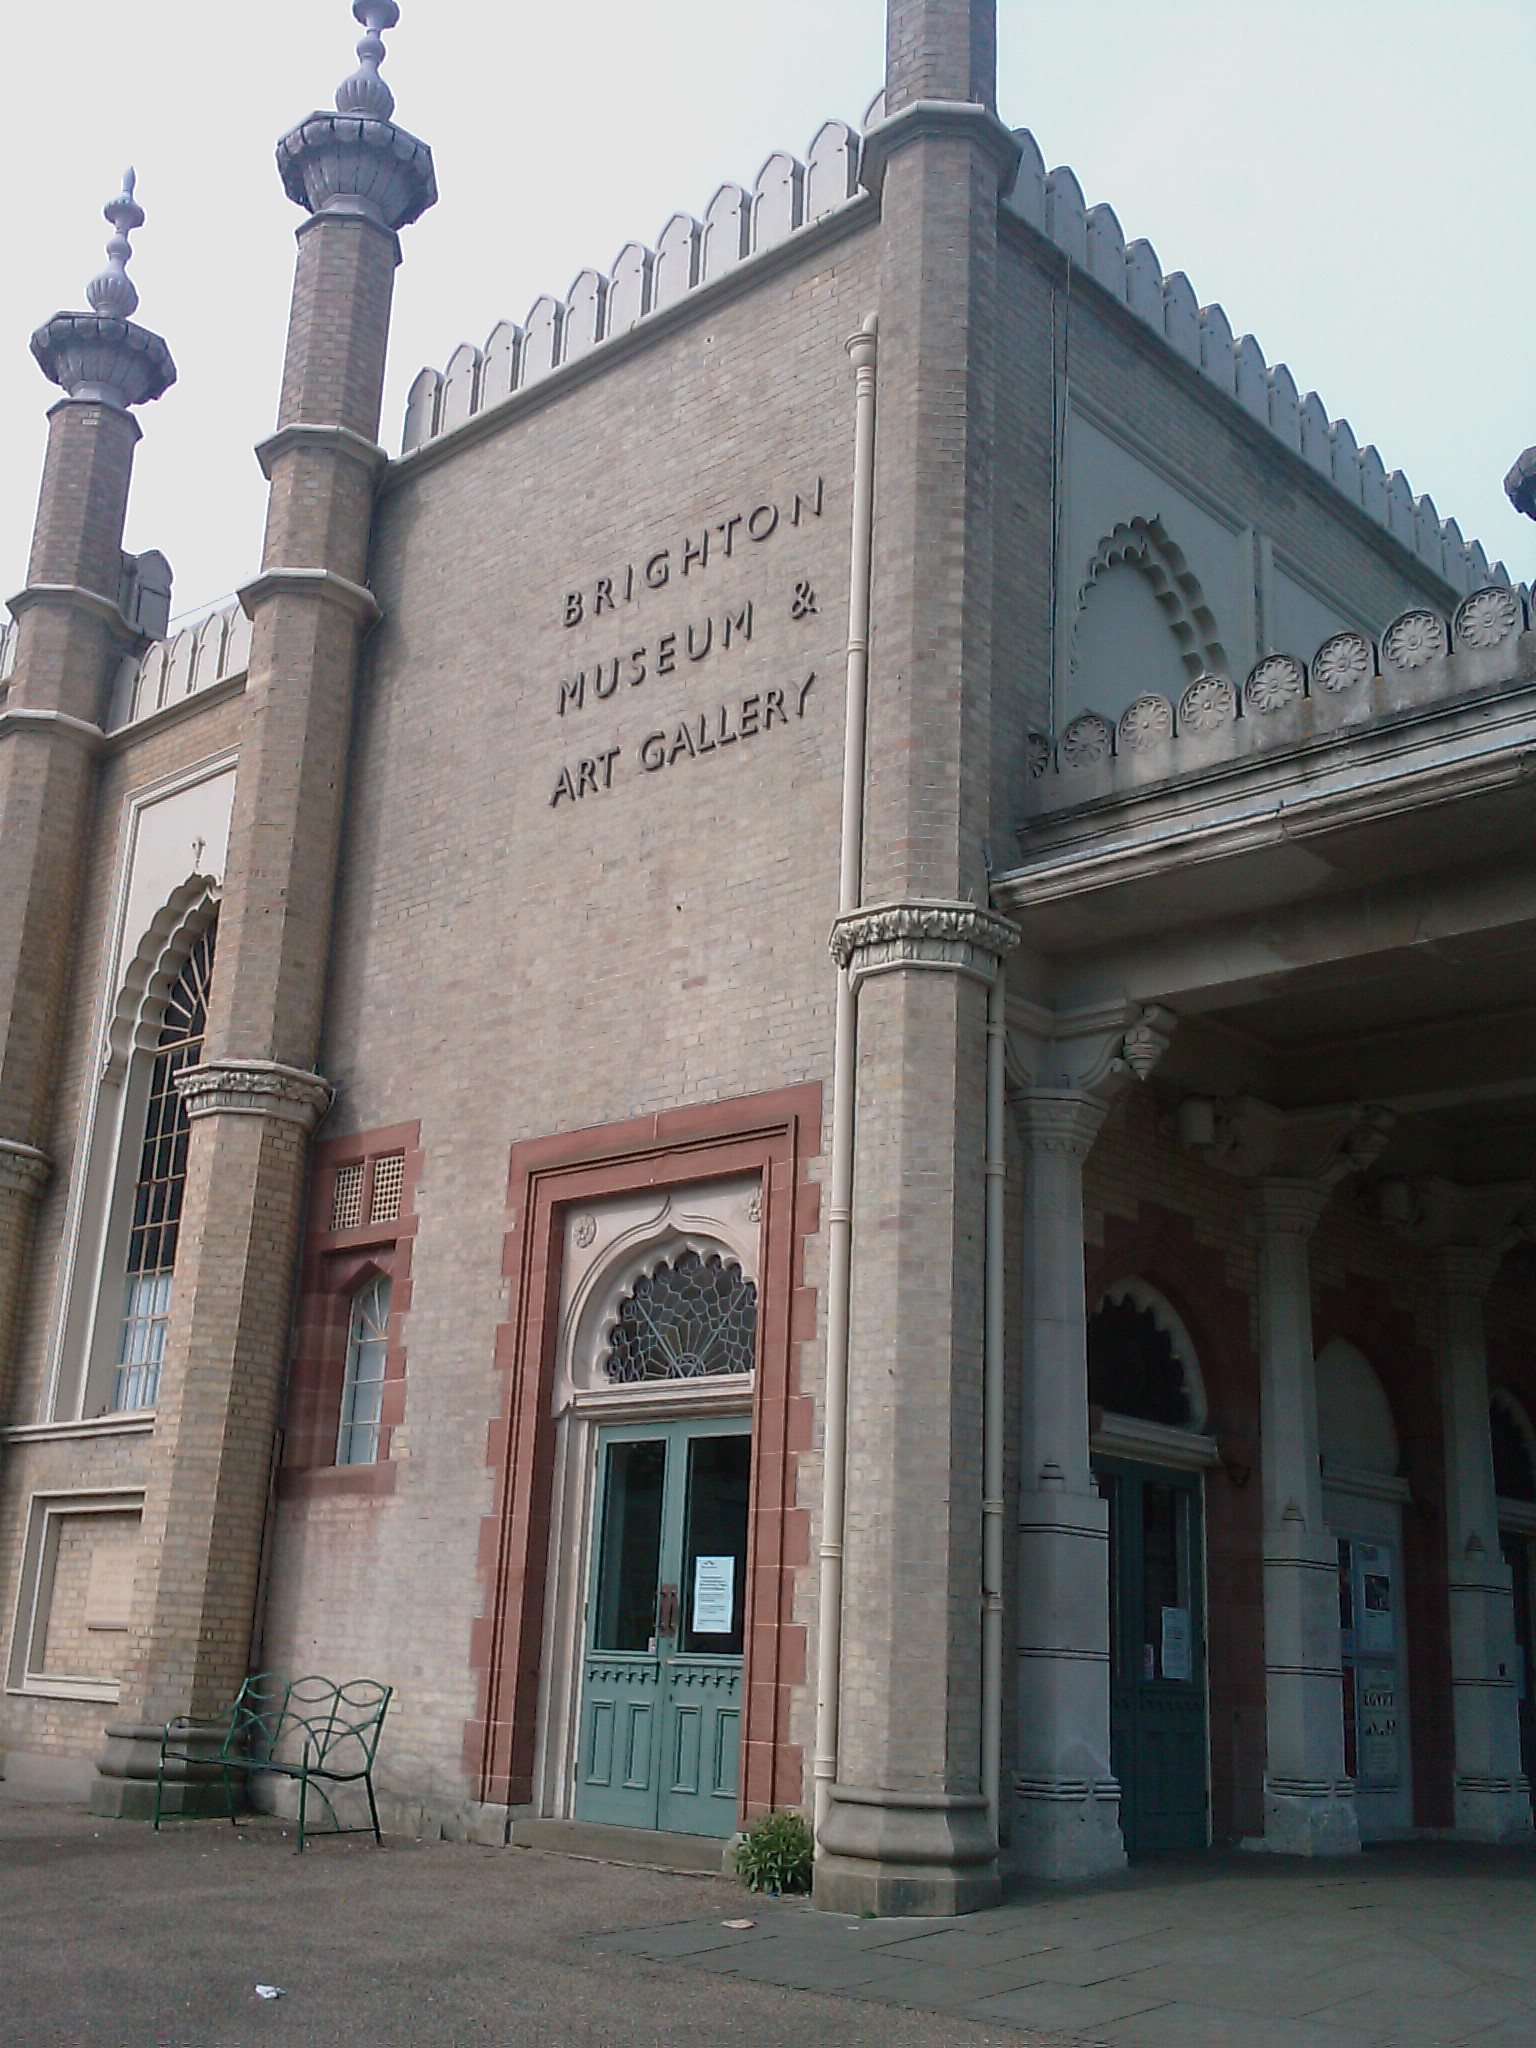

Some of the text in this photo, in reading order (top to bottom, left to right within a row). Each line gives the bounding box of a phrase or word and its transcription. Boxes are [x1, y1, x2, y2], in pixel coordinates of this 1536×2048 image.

[562, 476, 825, 628] BRIGHTON
[556, 579, 821, 717] MUSEUM &
[549, 671, 817, 808] ART GALLERY
